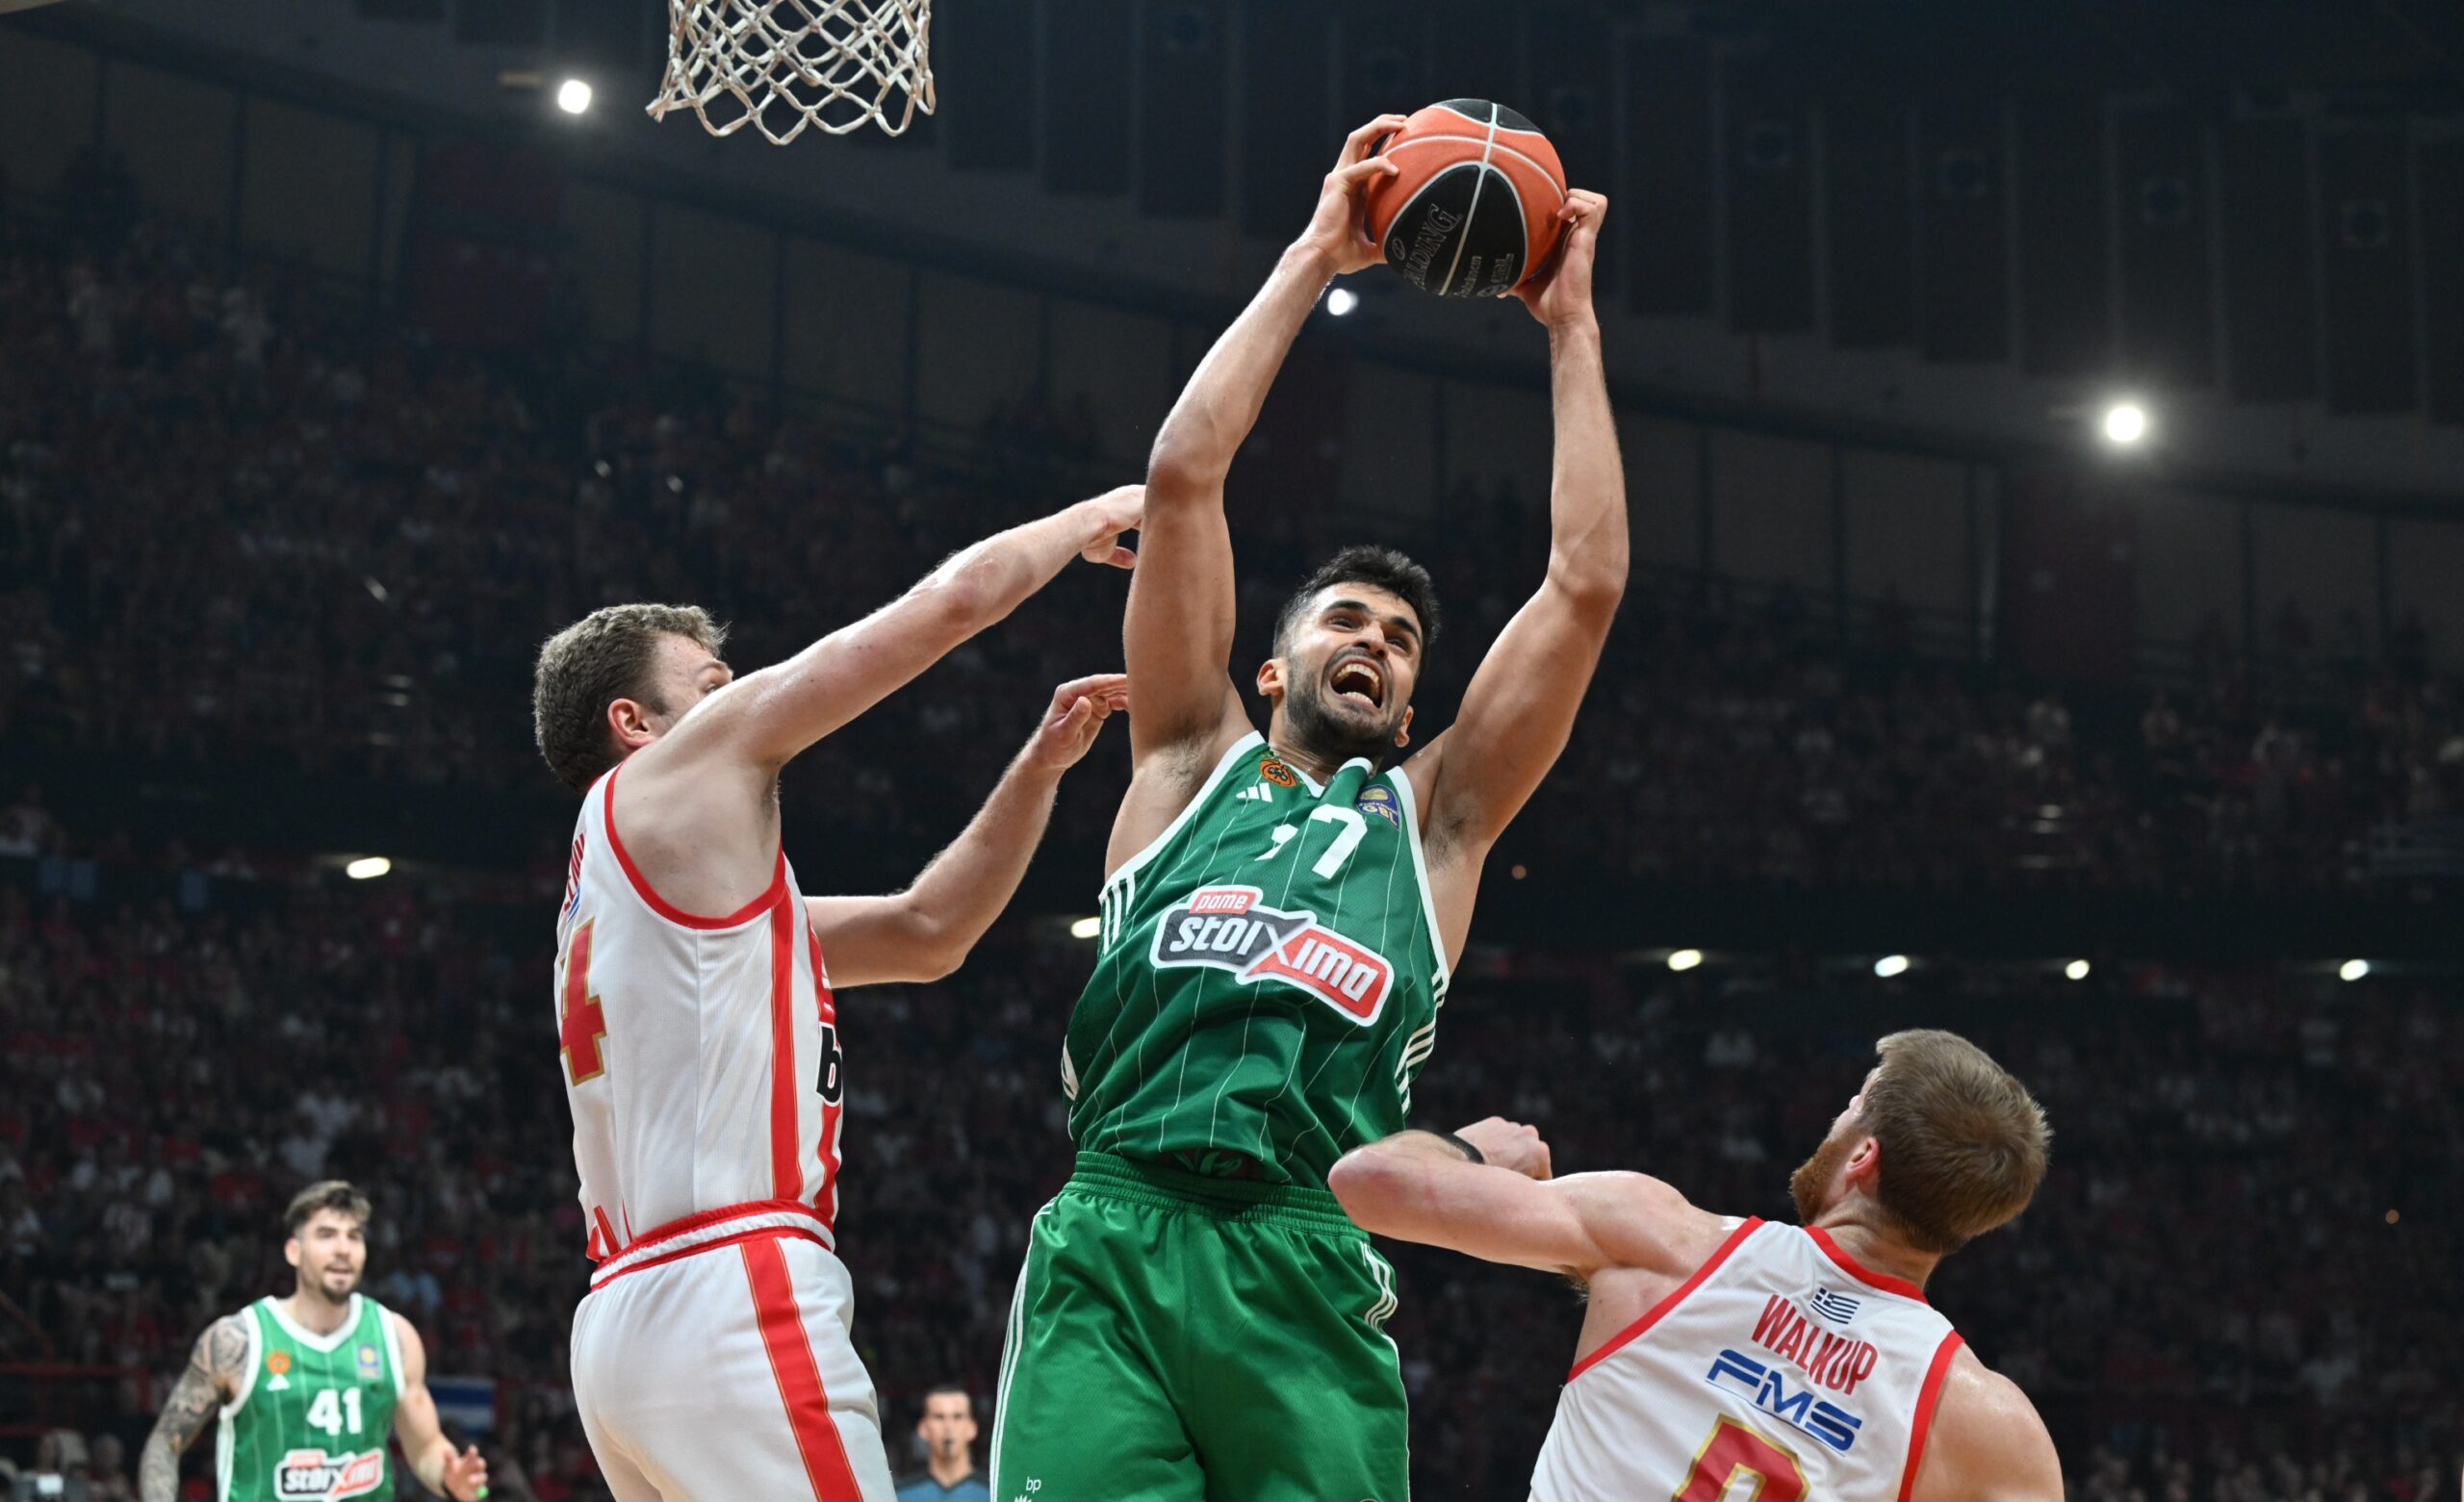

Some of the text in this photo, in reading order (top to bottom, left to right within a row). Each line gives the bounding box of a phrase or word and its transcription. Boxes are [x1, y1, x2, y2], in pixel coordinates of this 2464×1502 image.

[1195, 892, 1250, 910] pame
[1752, 1294, 1878, 1395] WALKUP
[306, 1387, 362, 1436] 41
[1707, 1349, 1862, 1451] FMS
[1026, 1476, 1041, 1494] bp
